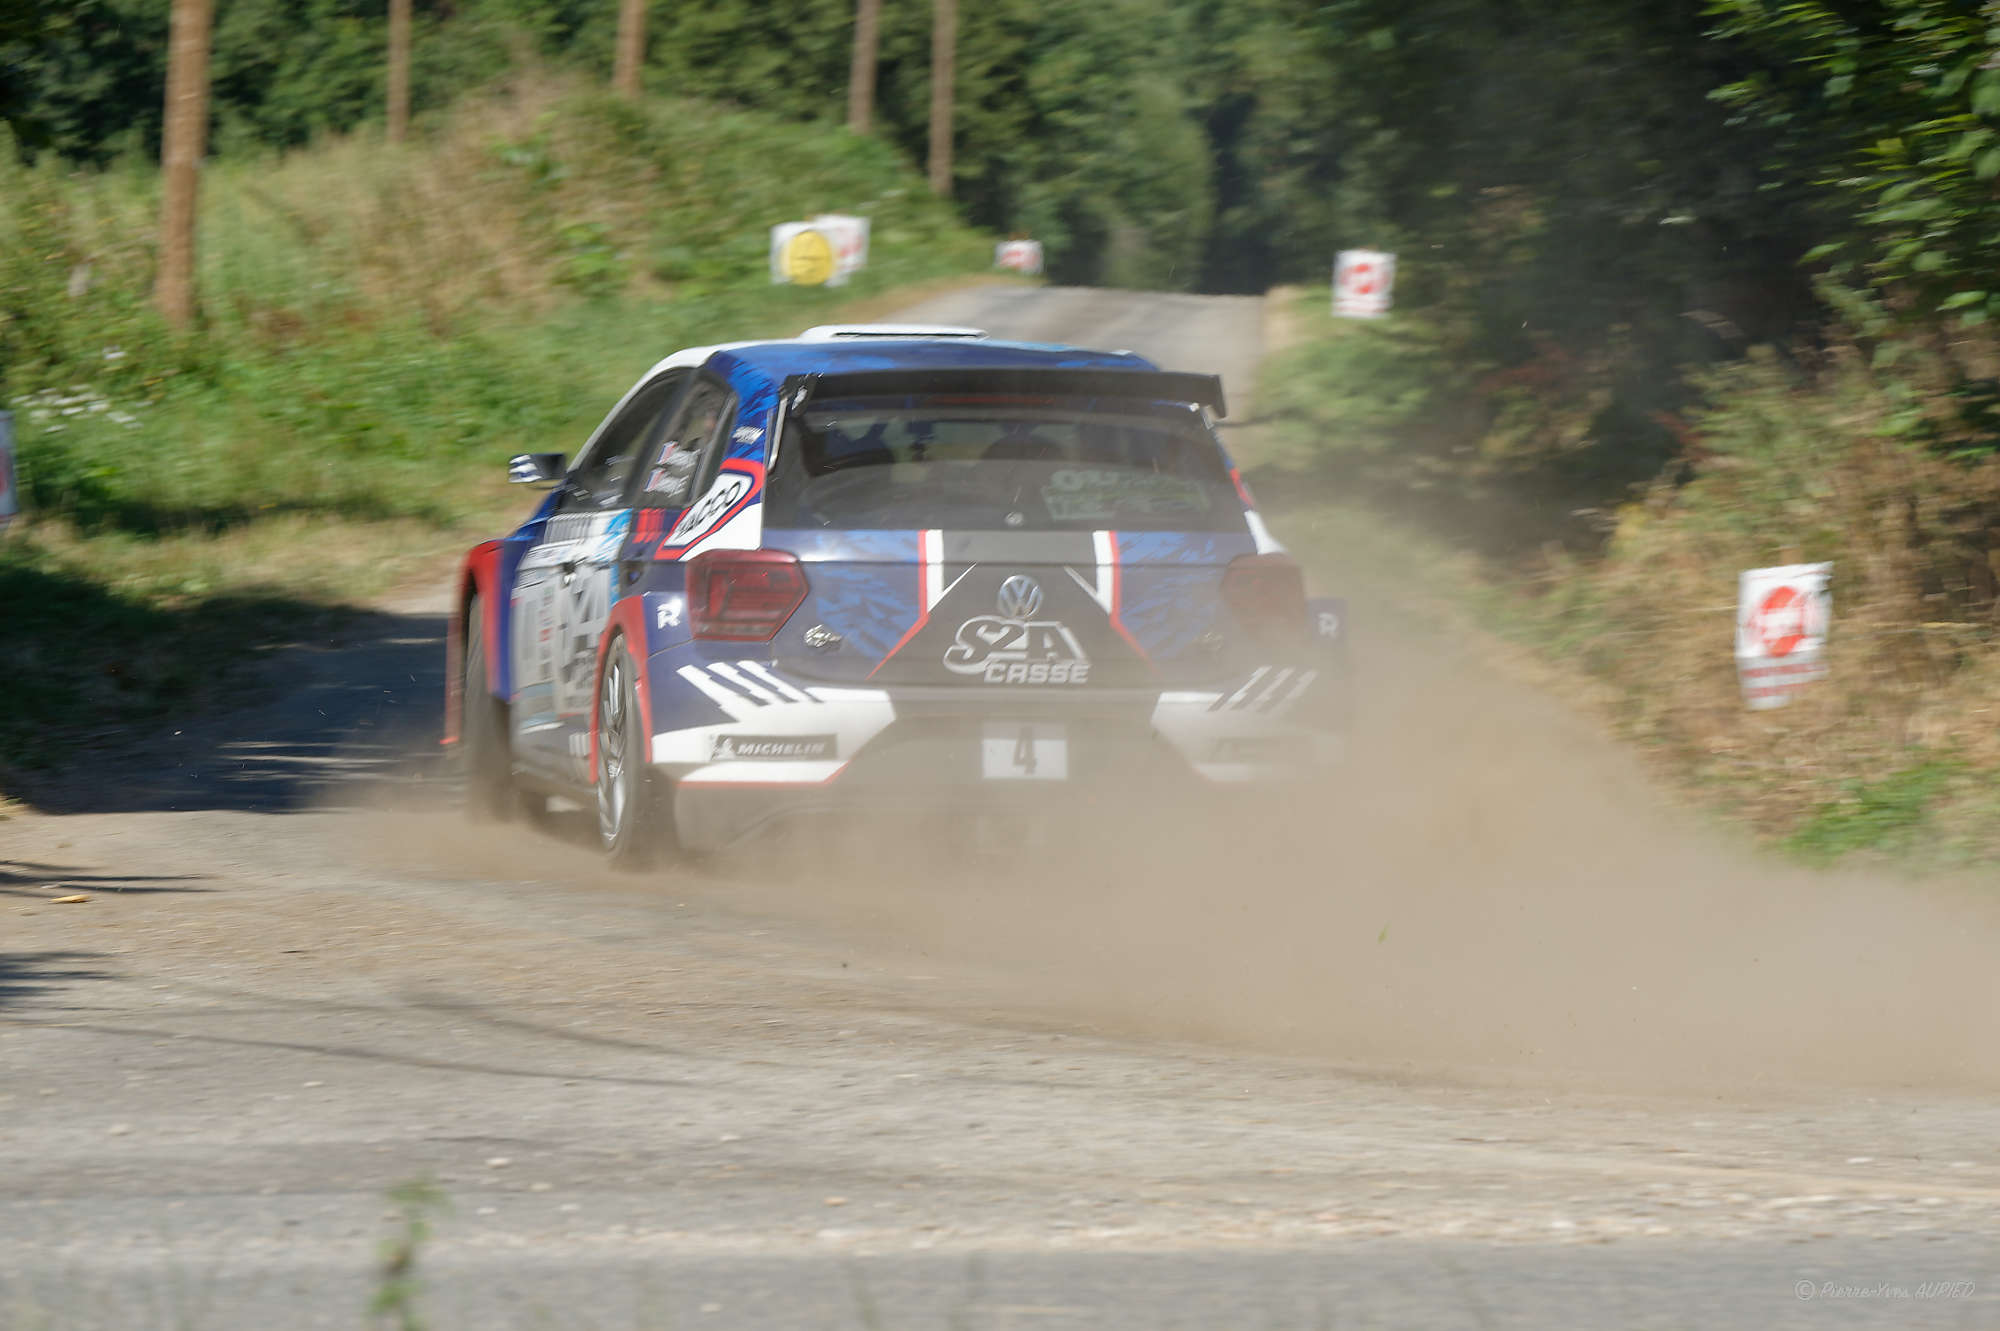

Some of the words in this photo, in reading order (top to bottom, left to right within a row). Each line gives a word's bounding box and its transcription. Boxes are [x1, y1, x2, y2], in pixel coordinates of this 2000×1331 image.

[984, 663, 1090, 683] CASSE
[737, 743, 825, 755] MICHELIN
[1012, 726, 1038, 777] 4
